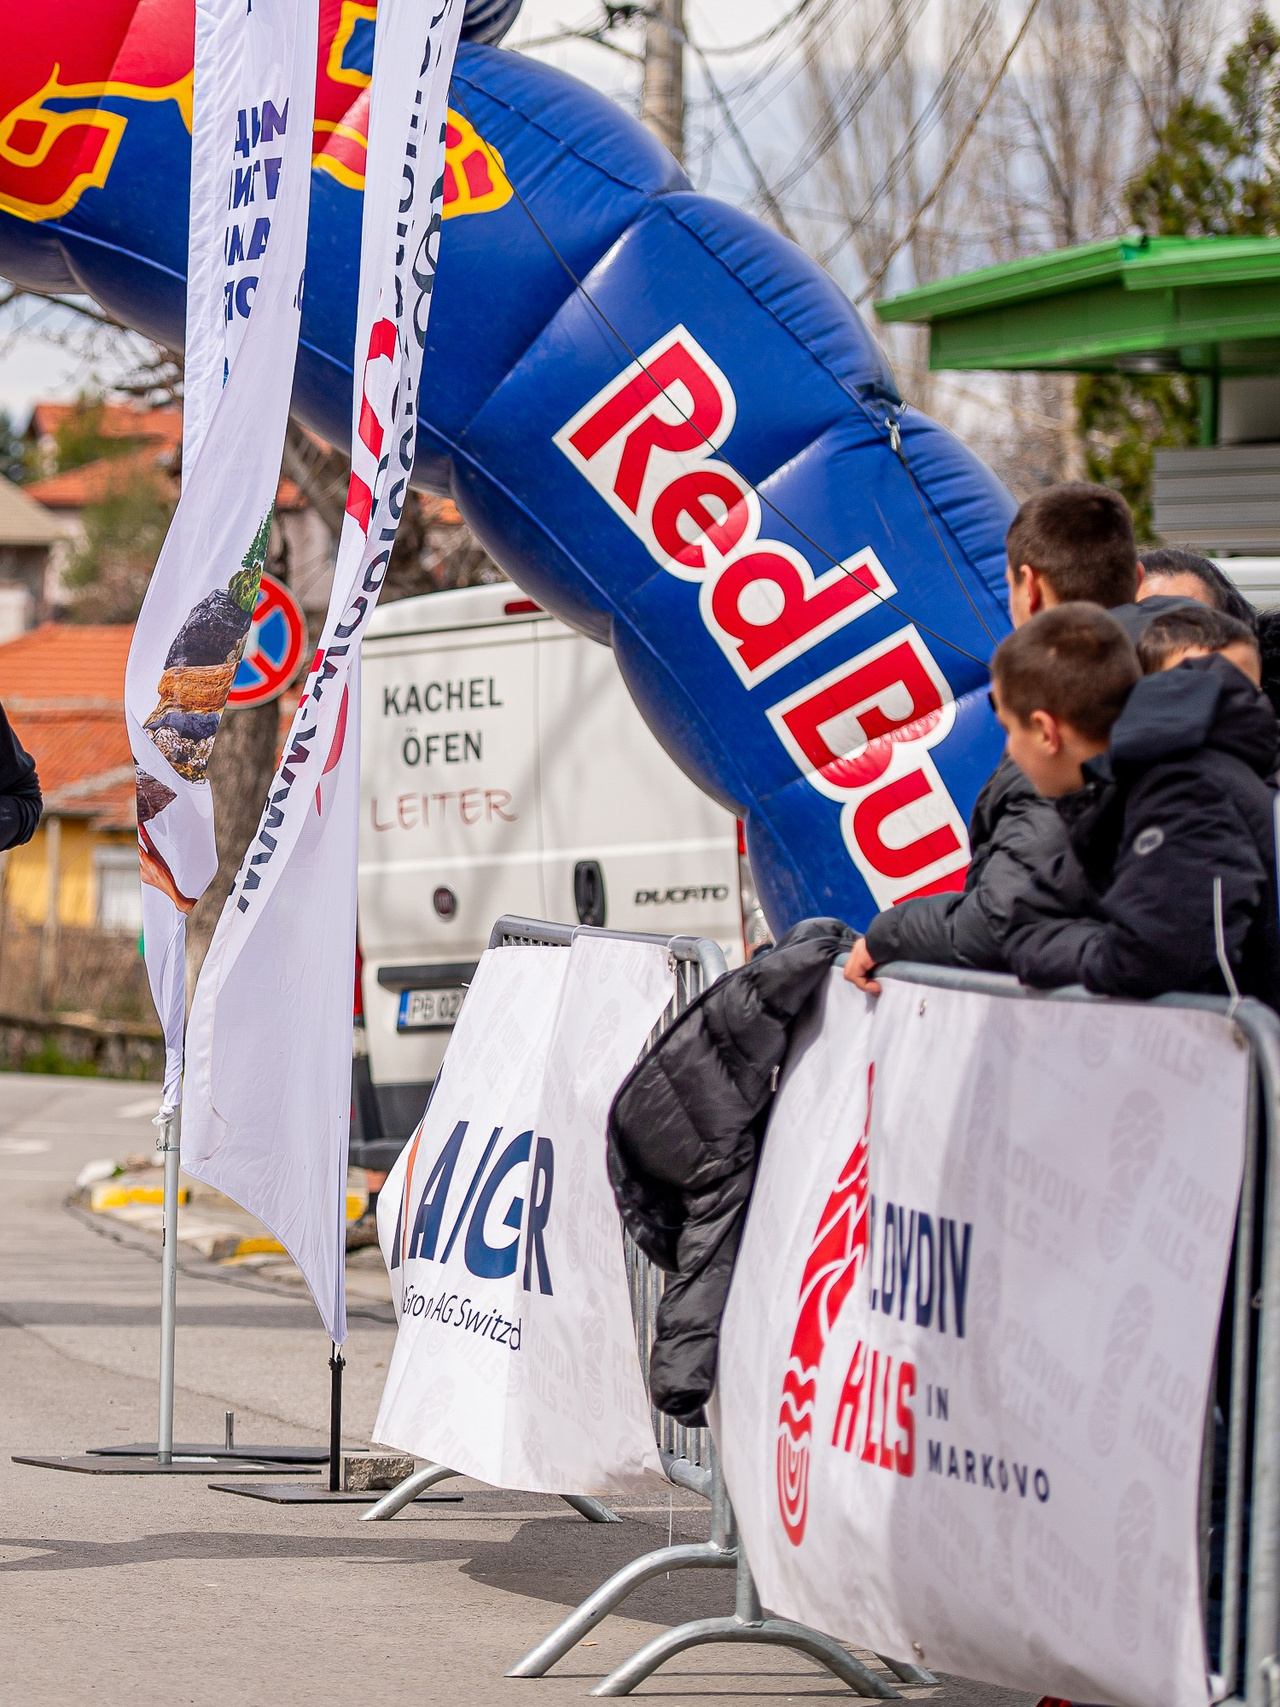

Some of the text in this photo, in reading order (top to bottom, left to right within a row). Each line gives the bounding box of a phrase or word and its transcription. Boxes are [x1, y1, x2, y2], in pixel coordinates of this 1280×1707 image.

[553, 324, 972, 911] Red Bu
[382, 678, 504, 717] KACHEL
[370, 787, 519, 832] LEITER
[634, 884, 730, 905] DUCATO
[870, 1194, 974, 1339] LOVDIV
[430, 1292, 458, 1323] AG
[831, 1340, 917, 1478] HLLS
[926, 1383, 949, 1422] IN
[927, 1439, 1051, 1504] MARKOVO
